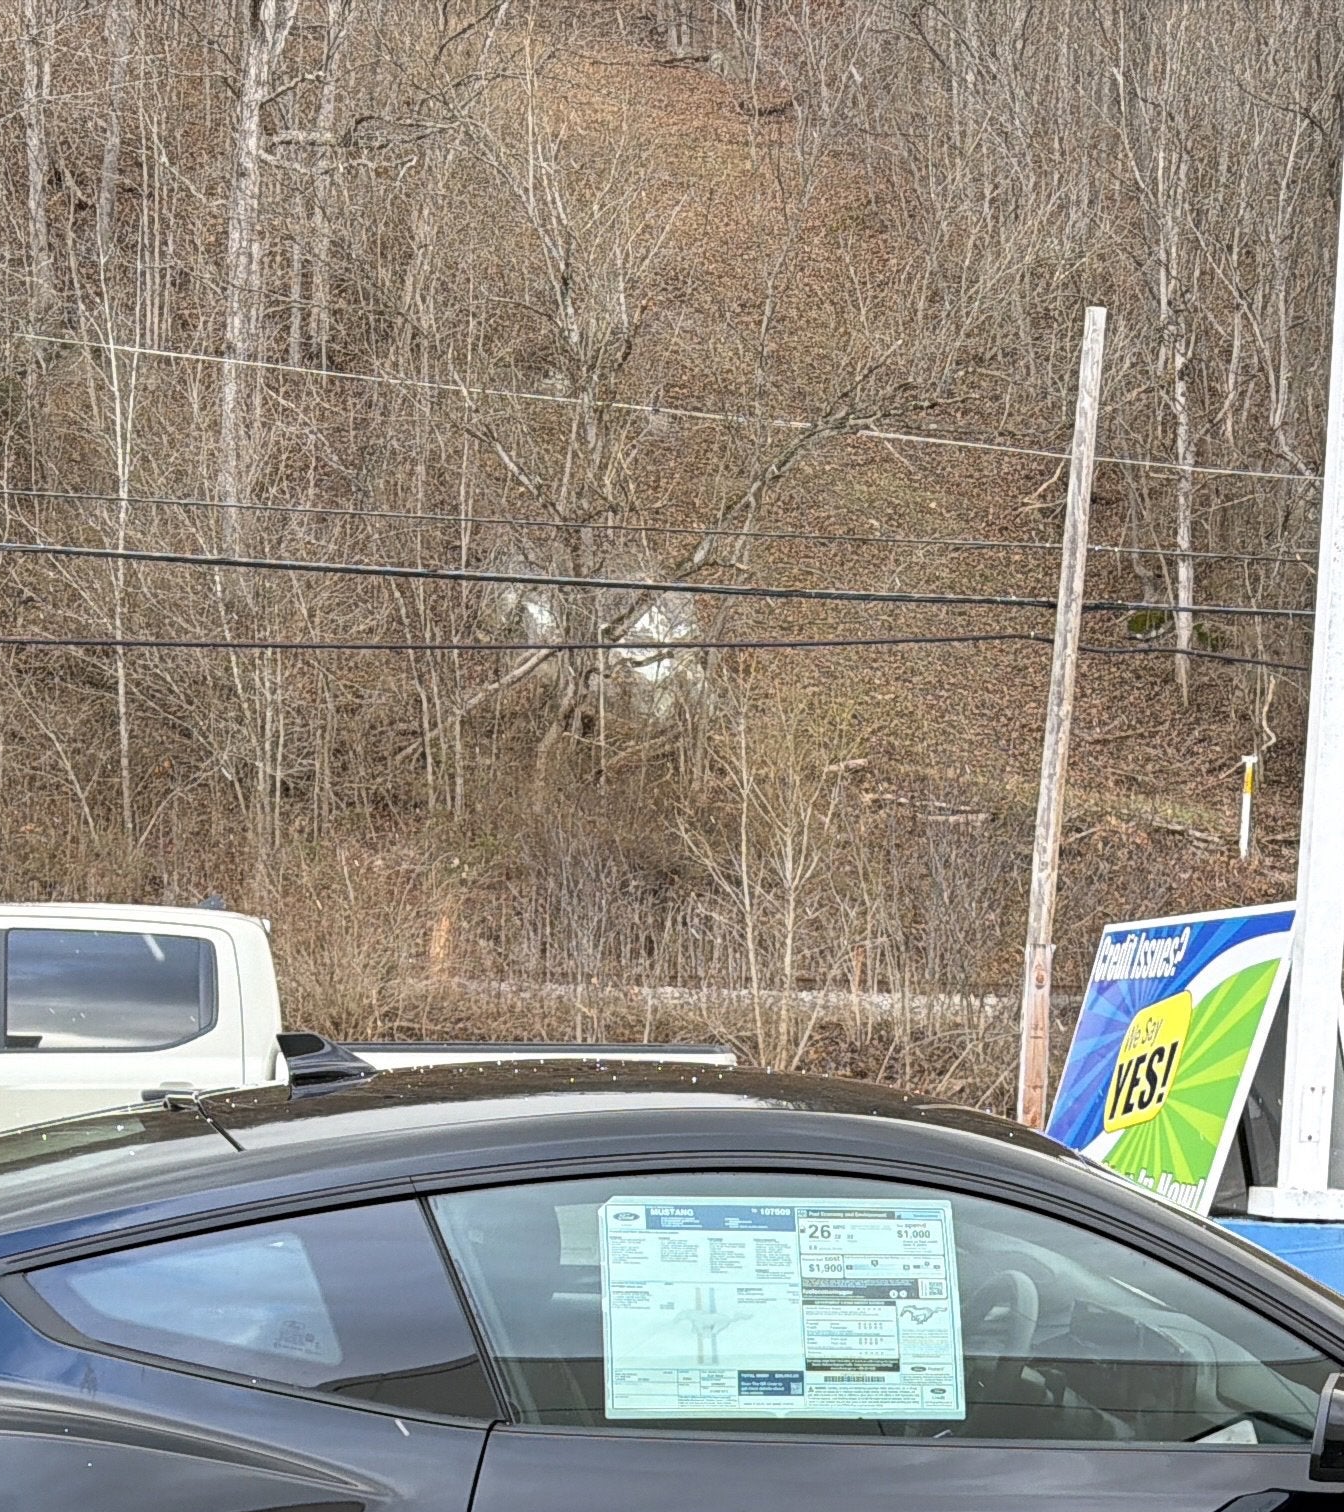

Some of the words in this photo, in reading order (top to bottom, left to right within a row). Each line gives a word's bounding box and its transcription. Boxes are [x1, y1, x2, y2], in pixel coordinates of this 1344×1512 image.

[1095, 931, 1138, 982] Credit
[1130, 927, 1191, 979] Issues?
[1124, 1024, 1142, 1053] We
[1142, 1017, 1164, 1047] Say
[1109, 1041, 1179, 1120] YES!
[650, 1208, 694, 1217] MUSTANG
[808, 1224, 832, 1239] 26
[896, 1229, 931, 1240] $1,000
[808, 1263, 843, 1274] $1,900
